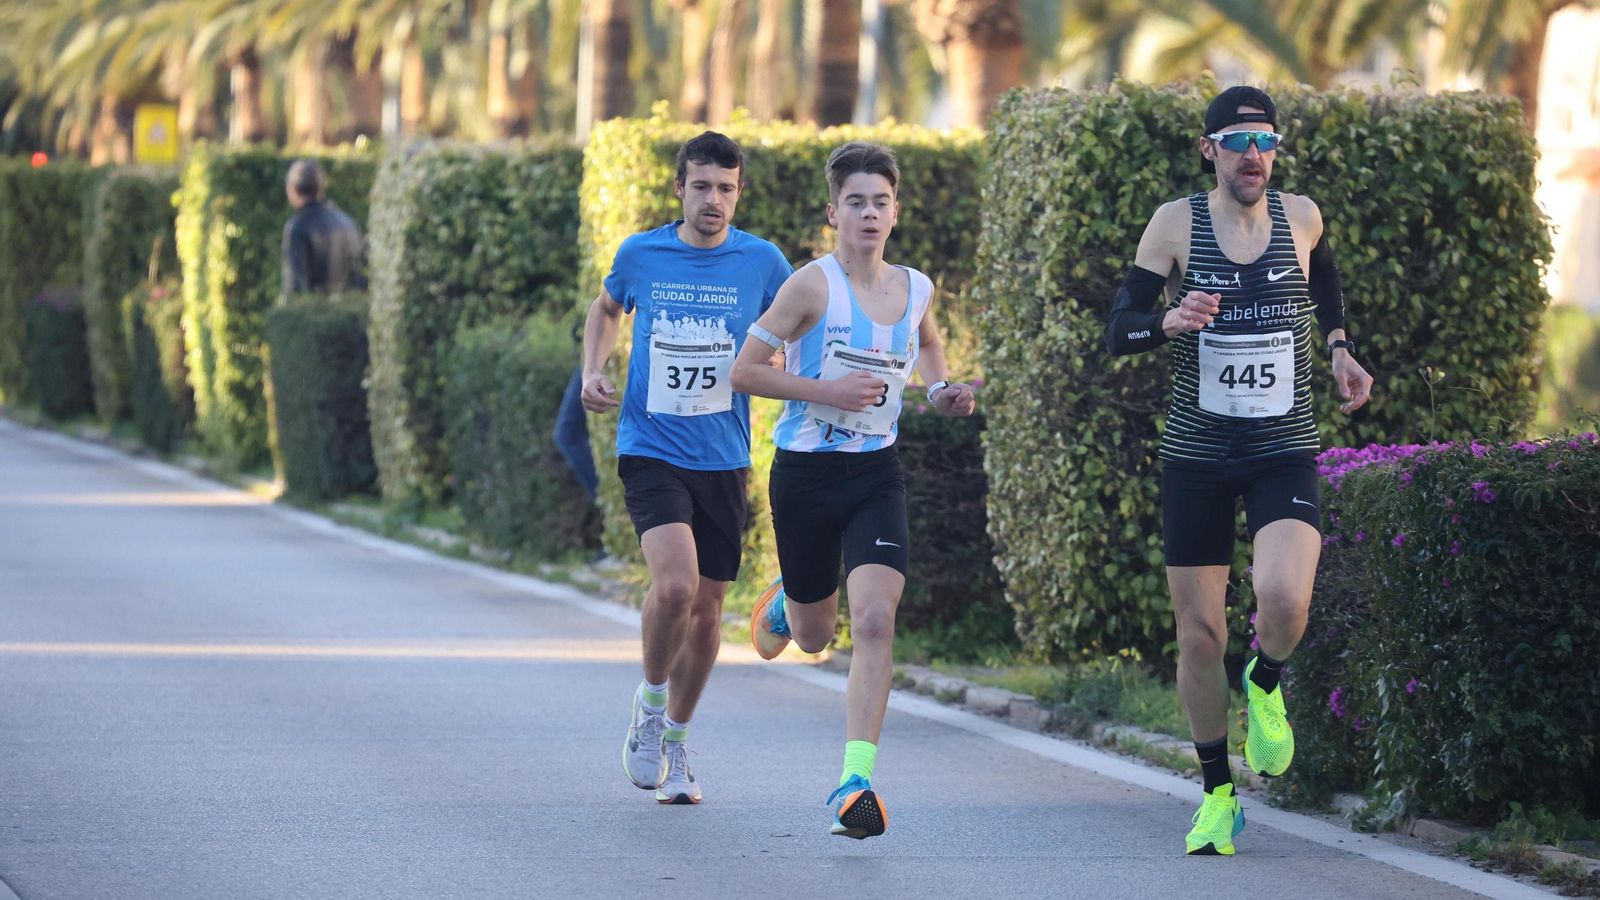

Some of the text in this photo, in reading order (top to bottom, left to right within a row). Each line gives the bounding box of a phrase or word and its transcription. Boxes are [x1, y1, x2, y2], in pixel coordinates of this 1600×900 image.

[1209, 274, 1230, 286] More
[661, 282, 696, 291] CARRERA
[697, 284, 727, 293] URBANA
[728, 286, 738, 294] DE
[651, 290, 738, 305] CIUDAD JARDÍN
[1222, 299, 1297, 321] abelenda
[1256, 317, 1297, 327] asesores
[827, 325, 851, 334] vive
[1127, 329, 1151, 340] KIPRUN
[667, 365, 716, 391] 375
[1219, 363, 1276, 389] 445
